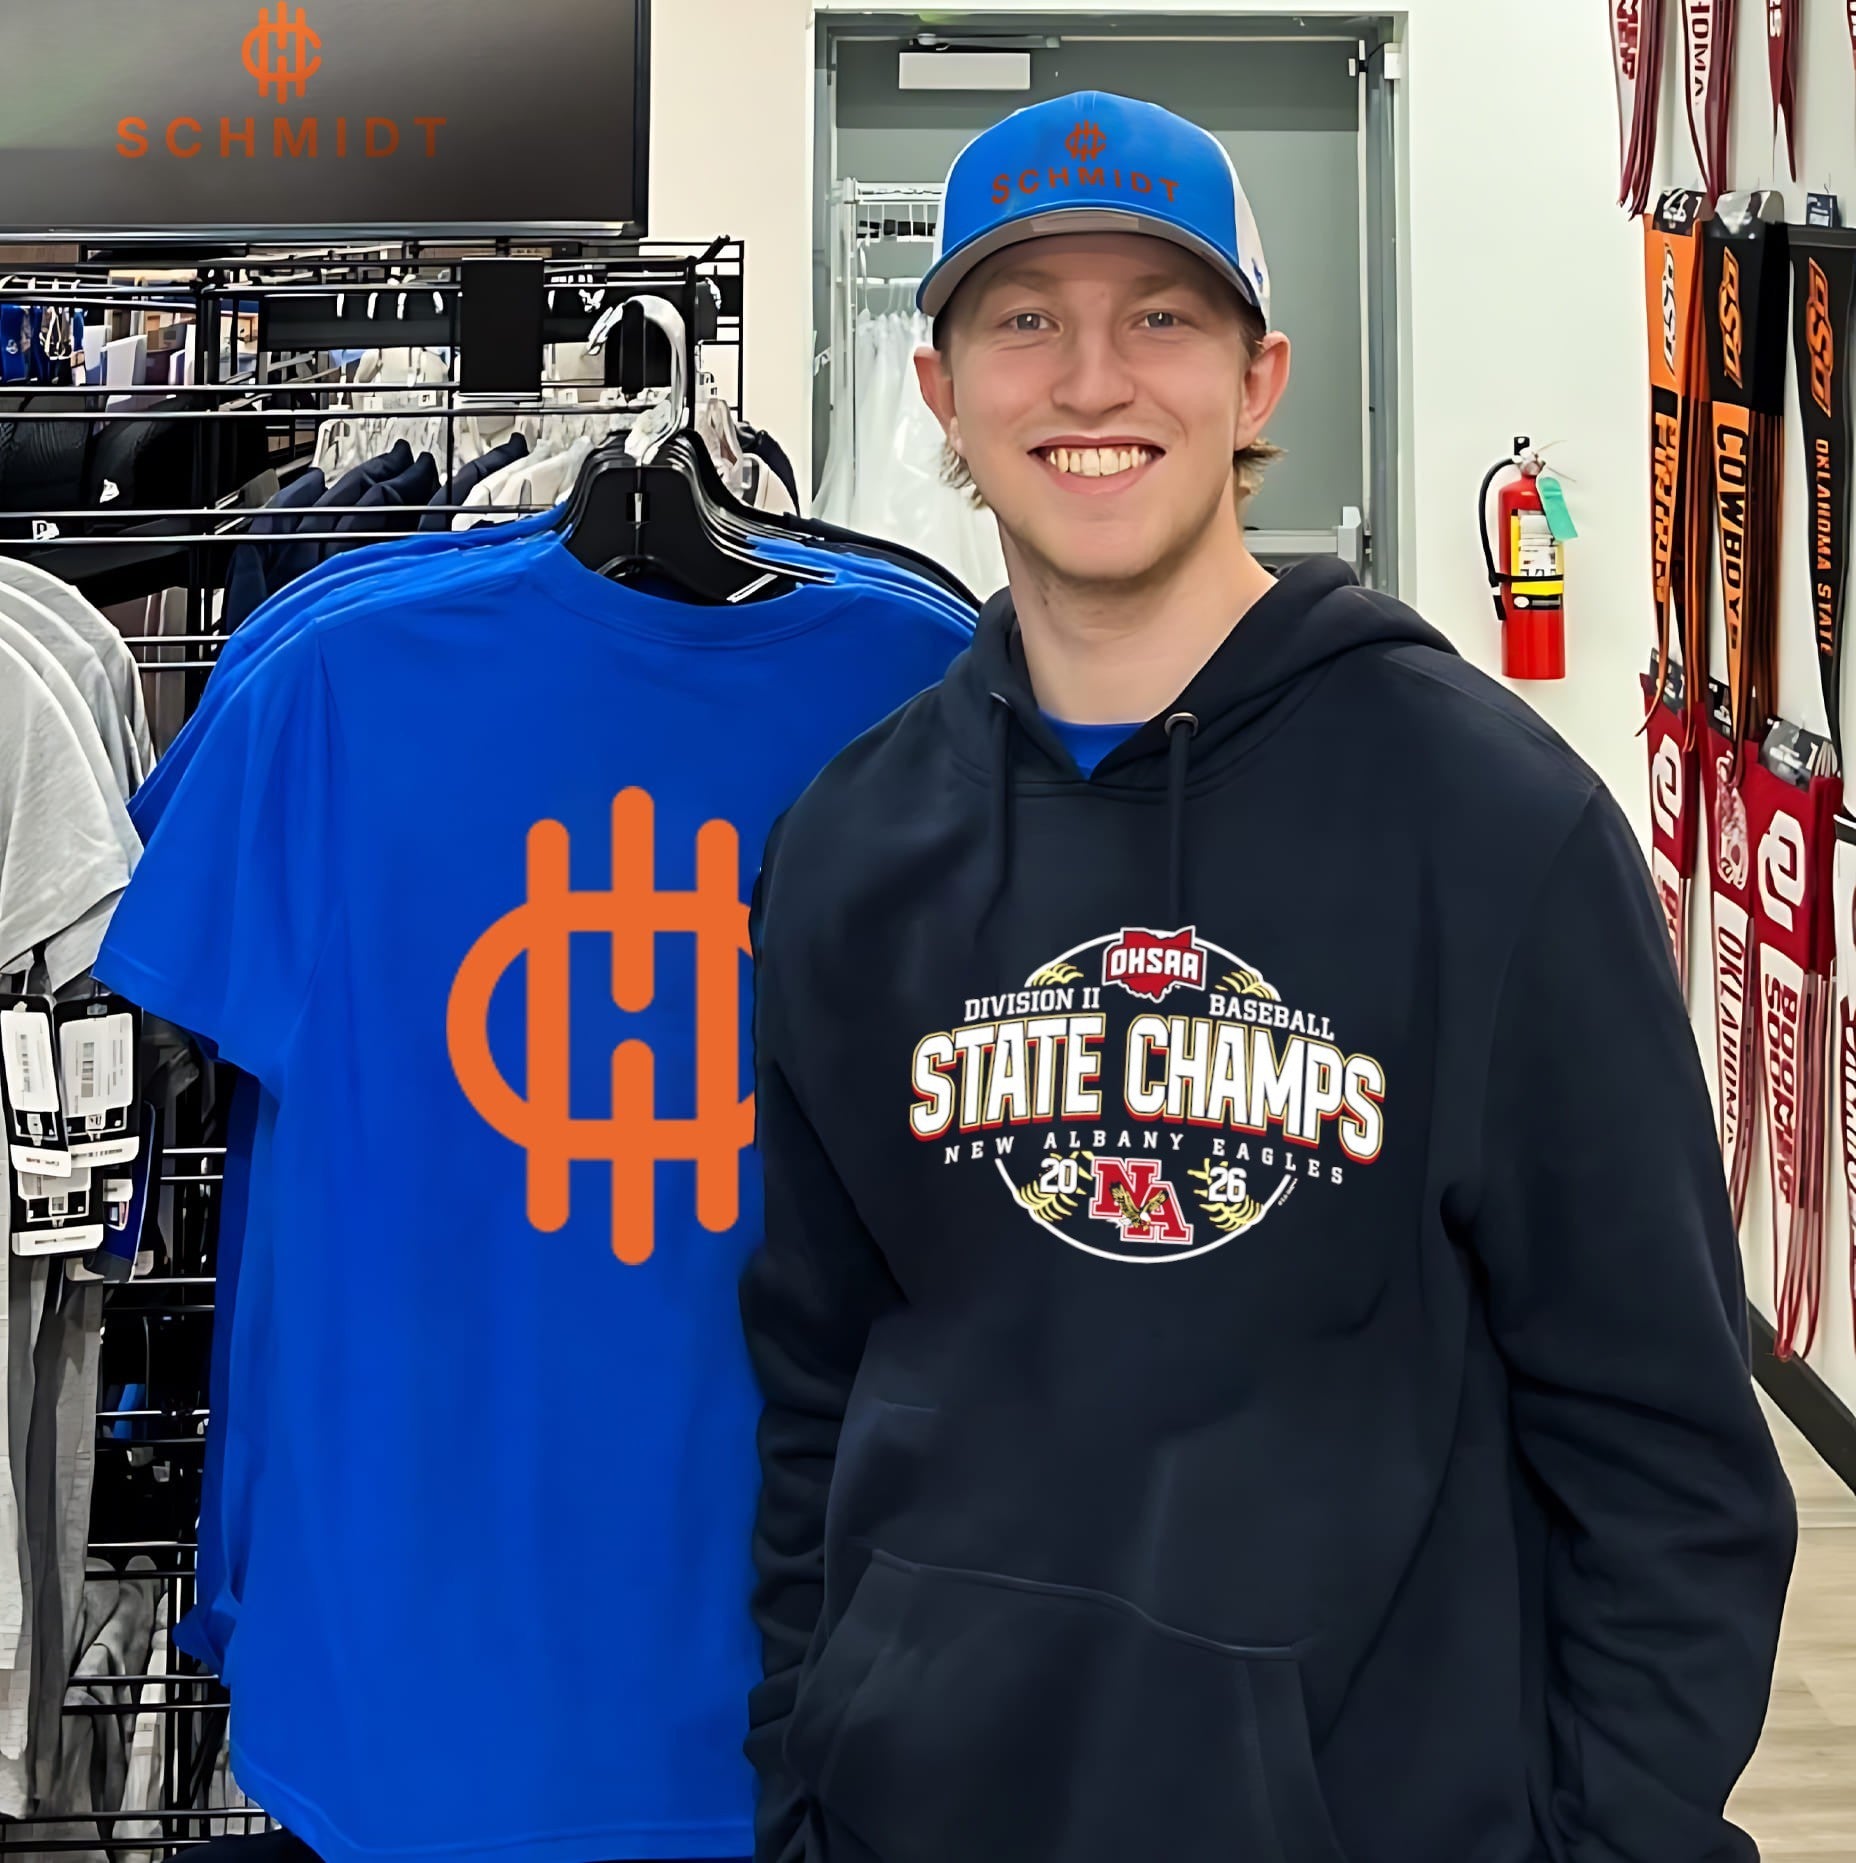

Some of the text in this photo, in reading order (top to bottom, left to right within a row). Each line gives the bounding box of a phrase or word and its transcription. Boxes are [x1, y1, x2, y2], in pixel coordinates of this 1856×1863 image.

[115, 116, 449, 159] SCHMIDT
[991, 167, 1179, 205] SCHMIDT
[1815, 438, 1832, 571] OKLAHOMA
[1109, 943, 1200, 981] OHSAA
[964, 987, 1335, 1041] DIVISION II BASEBALL
[909, 1013, 1386, 1165] STATE CHAMPS
[944, 1130, 1343, 1184] NEW ALBANY EAGLES
[1040, 1158, 1079, 1194] 20
[1089, 1156, 1194, 1245] NA
[1208, 1166, 1247, 1202] 26
